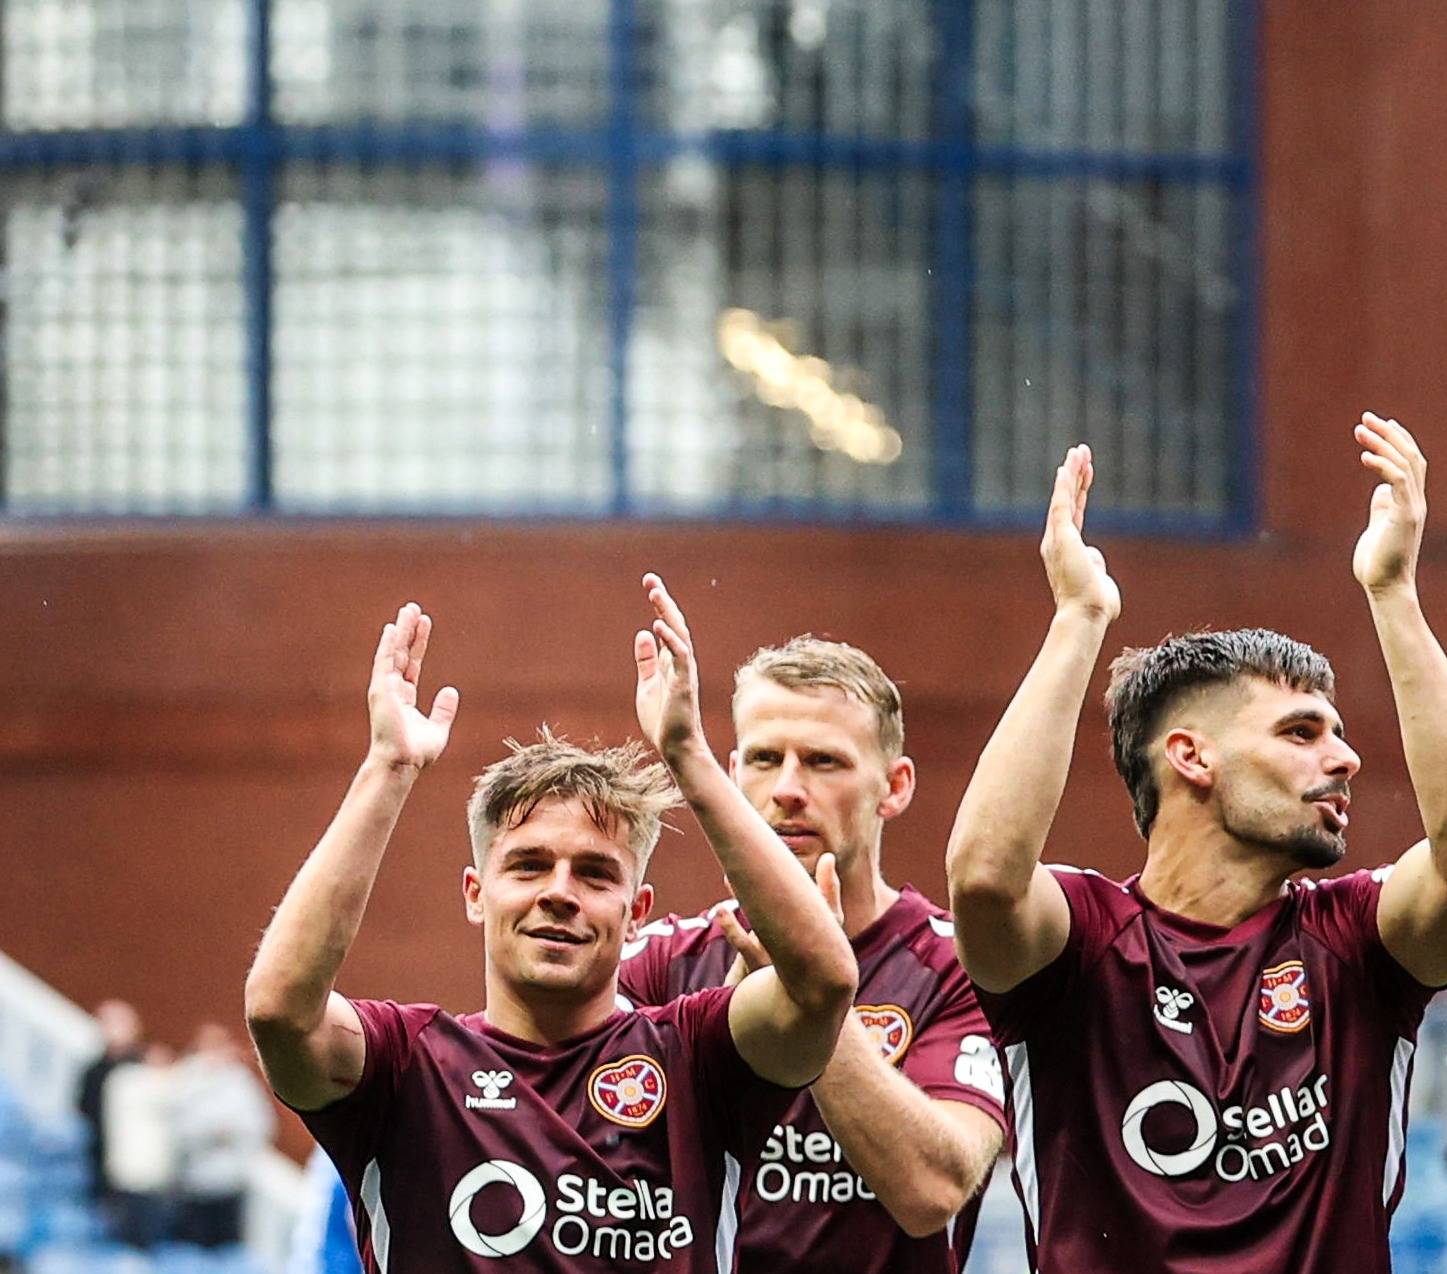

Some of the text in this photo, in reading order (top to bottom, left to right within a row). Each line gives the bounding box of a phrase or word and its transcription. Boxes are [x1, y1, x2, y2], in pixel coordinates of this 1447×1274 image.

[1222, 1074, 1328, 1140] Sellar
[1216, 1112, 1330, 1181] Omad
[555, 1174, 673, 1220] Stella
